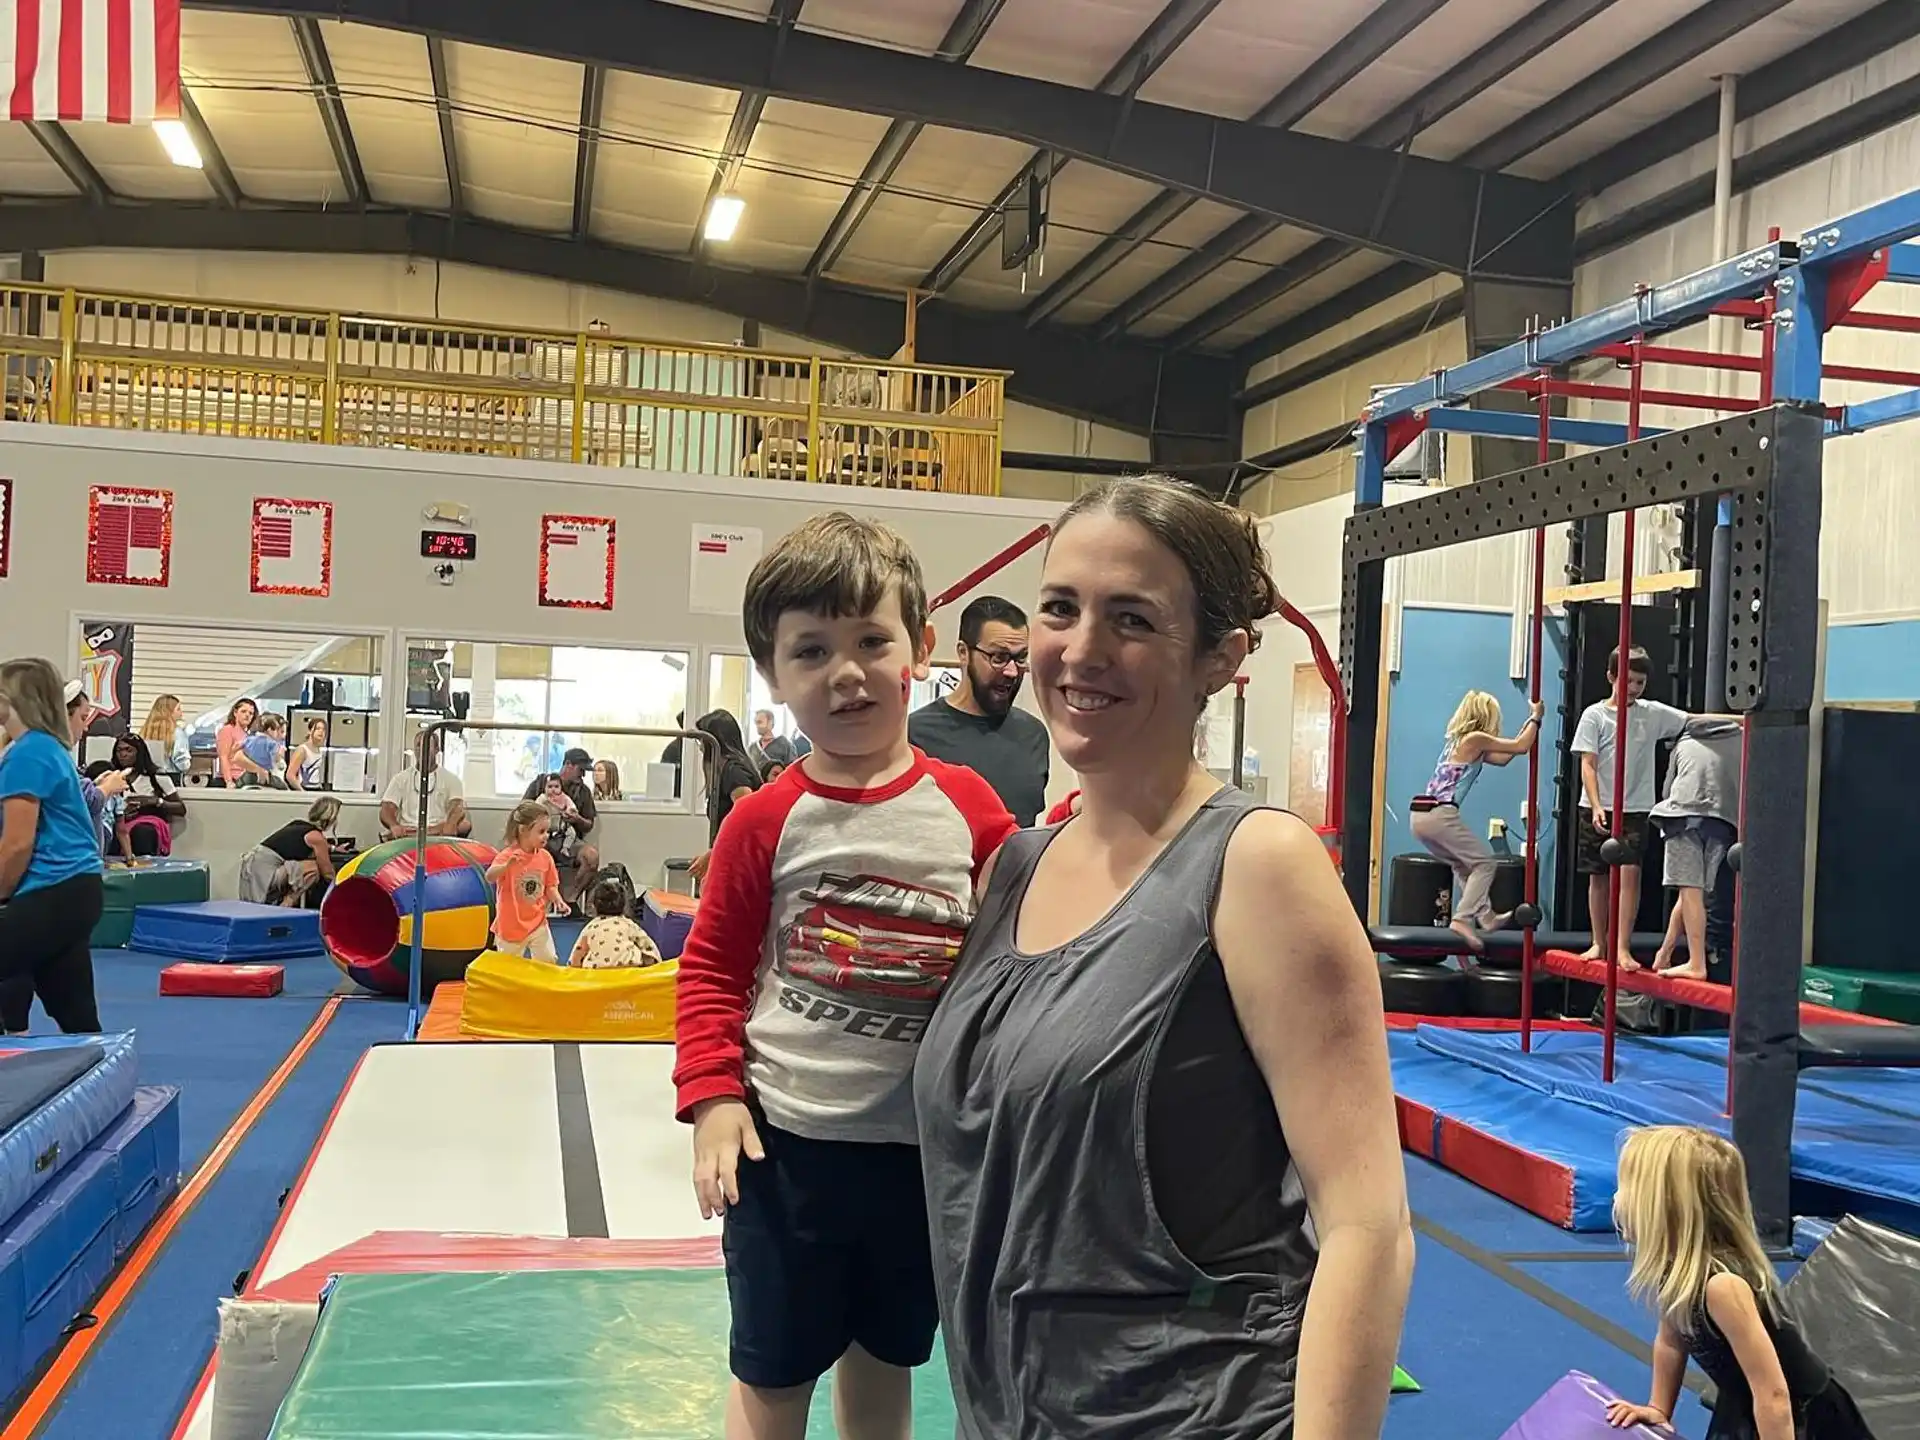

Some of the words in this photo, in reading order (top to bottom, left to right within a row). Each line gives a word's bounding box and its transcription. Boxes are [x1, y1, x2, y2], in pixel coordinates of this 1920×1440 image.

[133, 496, 150, 504] Club
[295, 508, 311, 516] Club
[581, 525, 596, 533] Club
[729, 534, 744, 542] Club
[602, 1010, 654, 1021] AMERICAN
[778, 986, 928, 1043] SPEE
